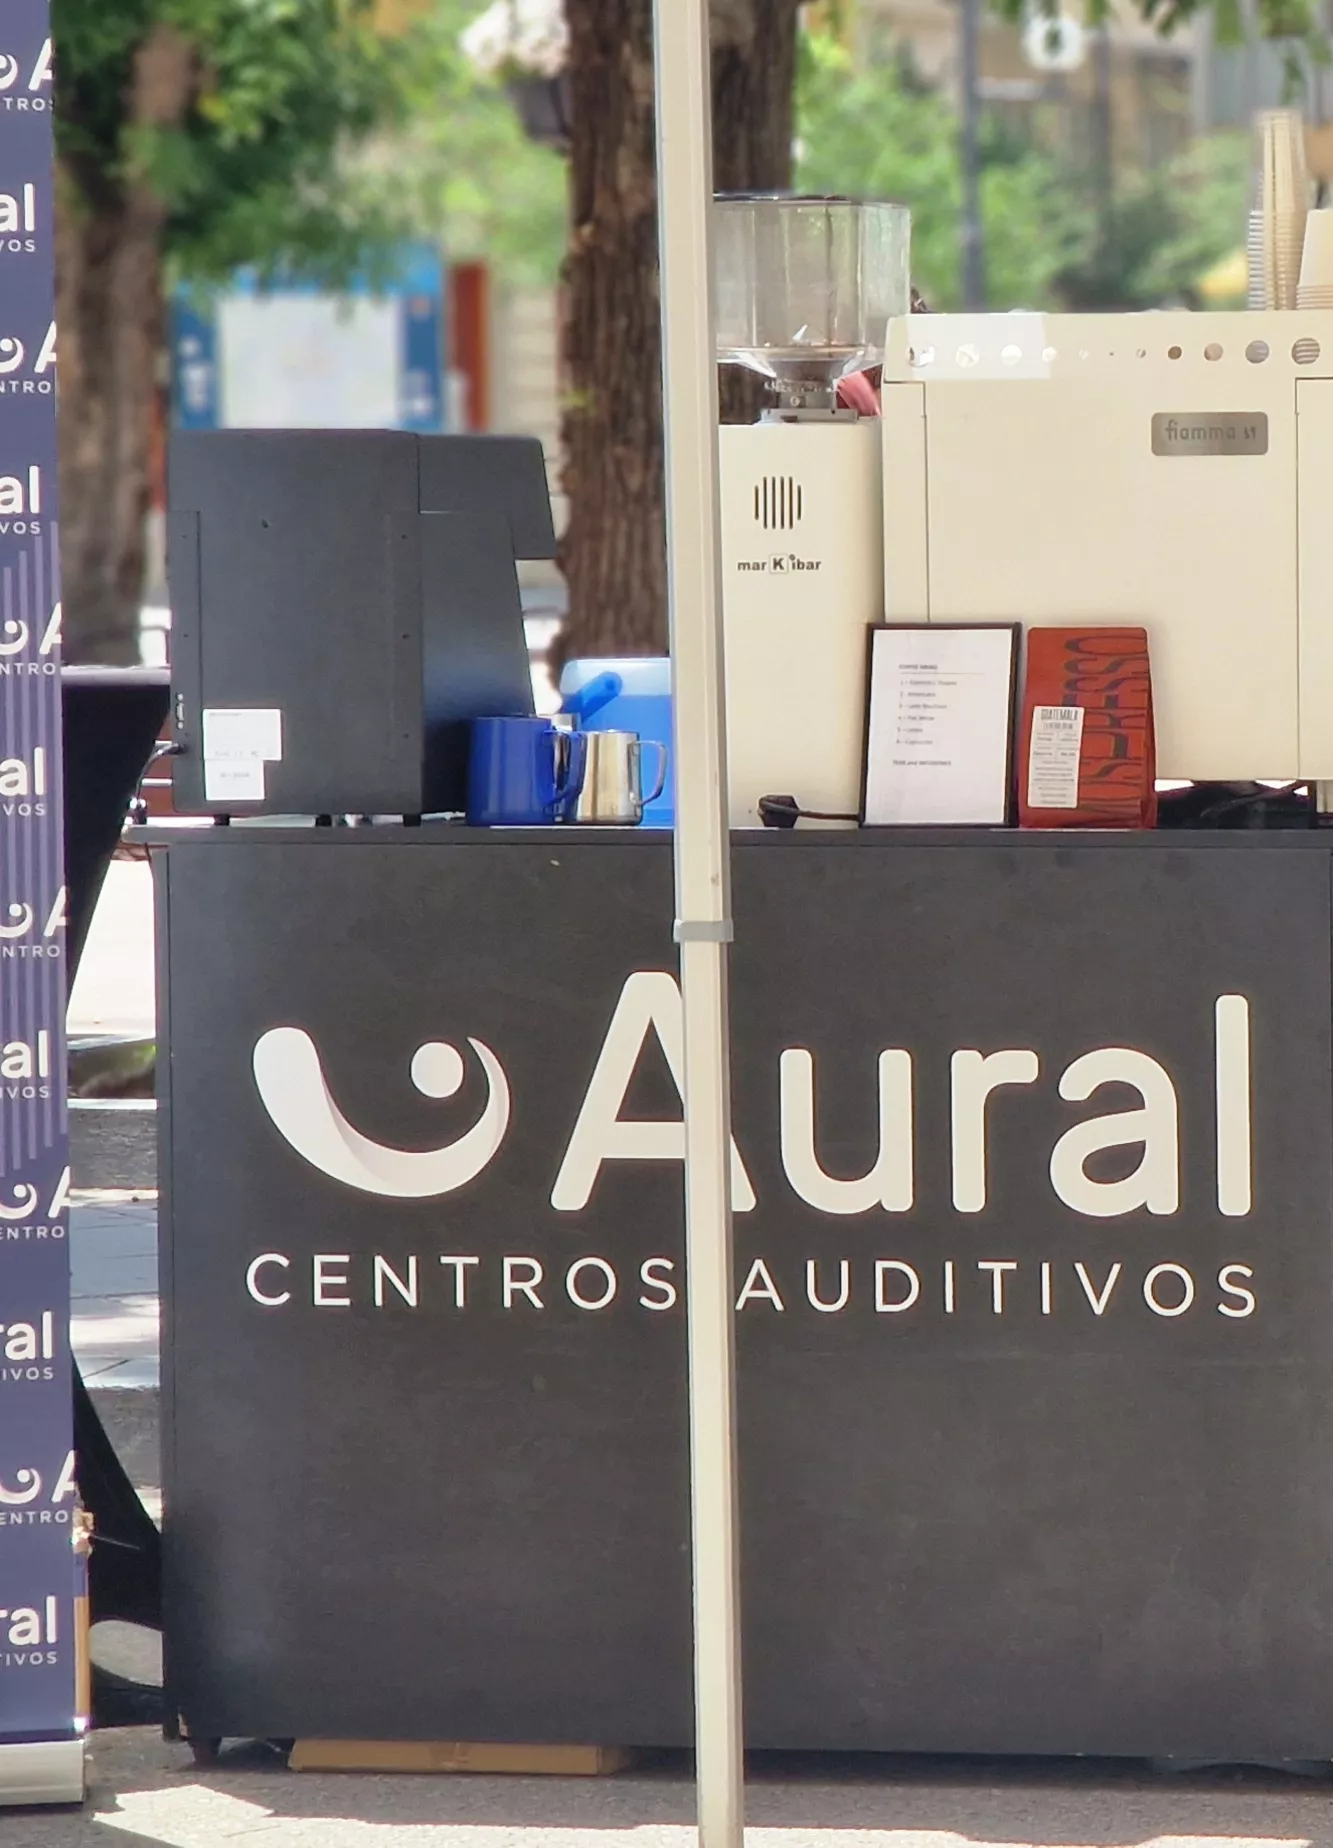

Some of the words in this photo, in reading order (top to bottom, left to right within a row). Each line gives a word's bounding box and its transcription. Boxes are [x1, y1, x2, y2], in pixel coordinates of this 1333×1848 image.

[1165, 419, 1236, 440] fiamma
[551, 971, 1251, 1217] Aural
[246, 1253, 677, 1311] CENTROS
[735, 1257, 1257, 1318] AUDITIVOS
